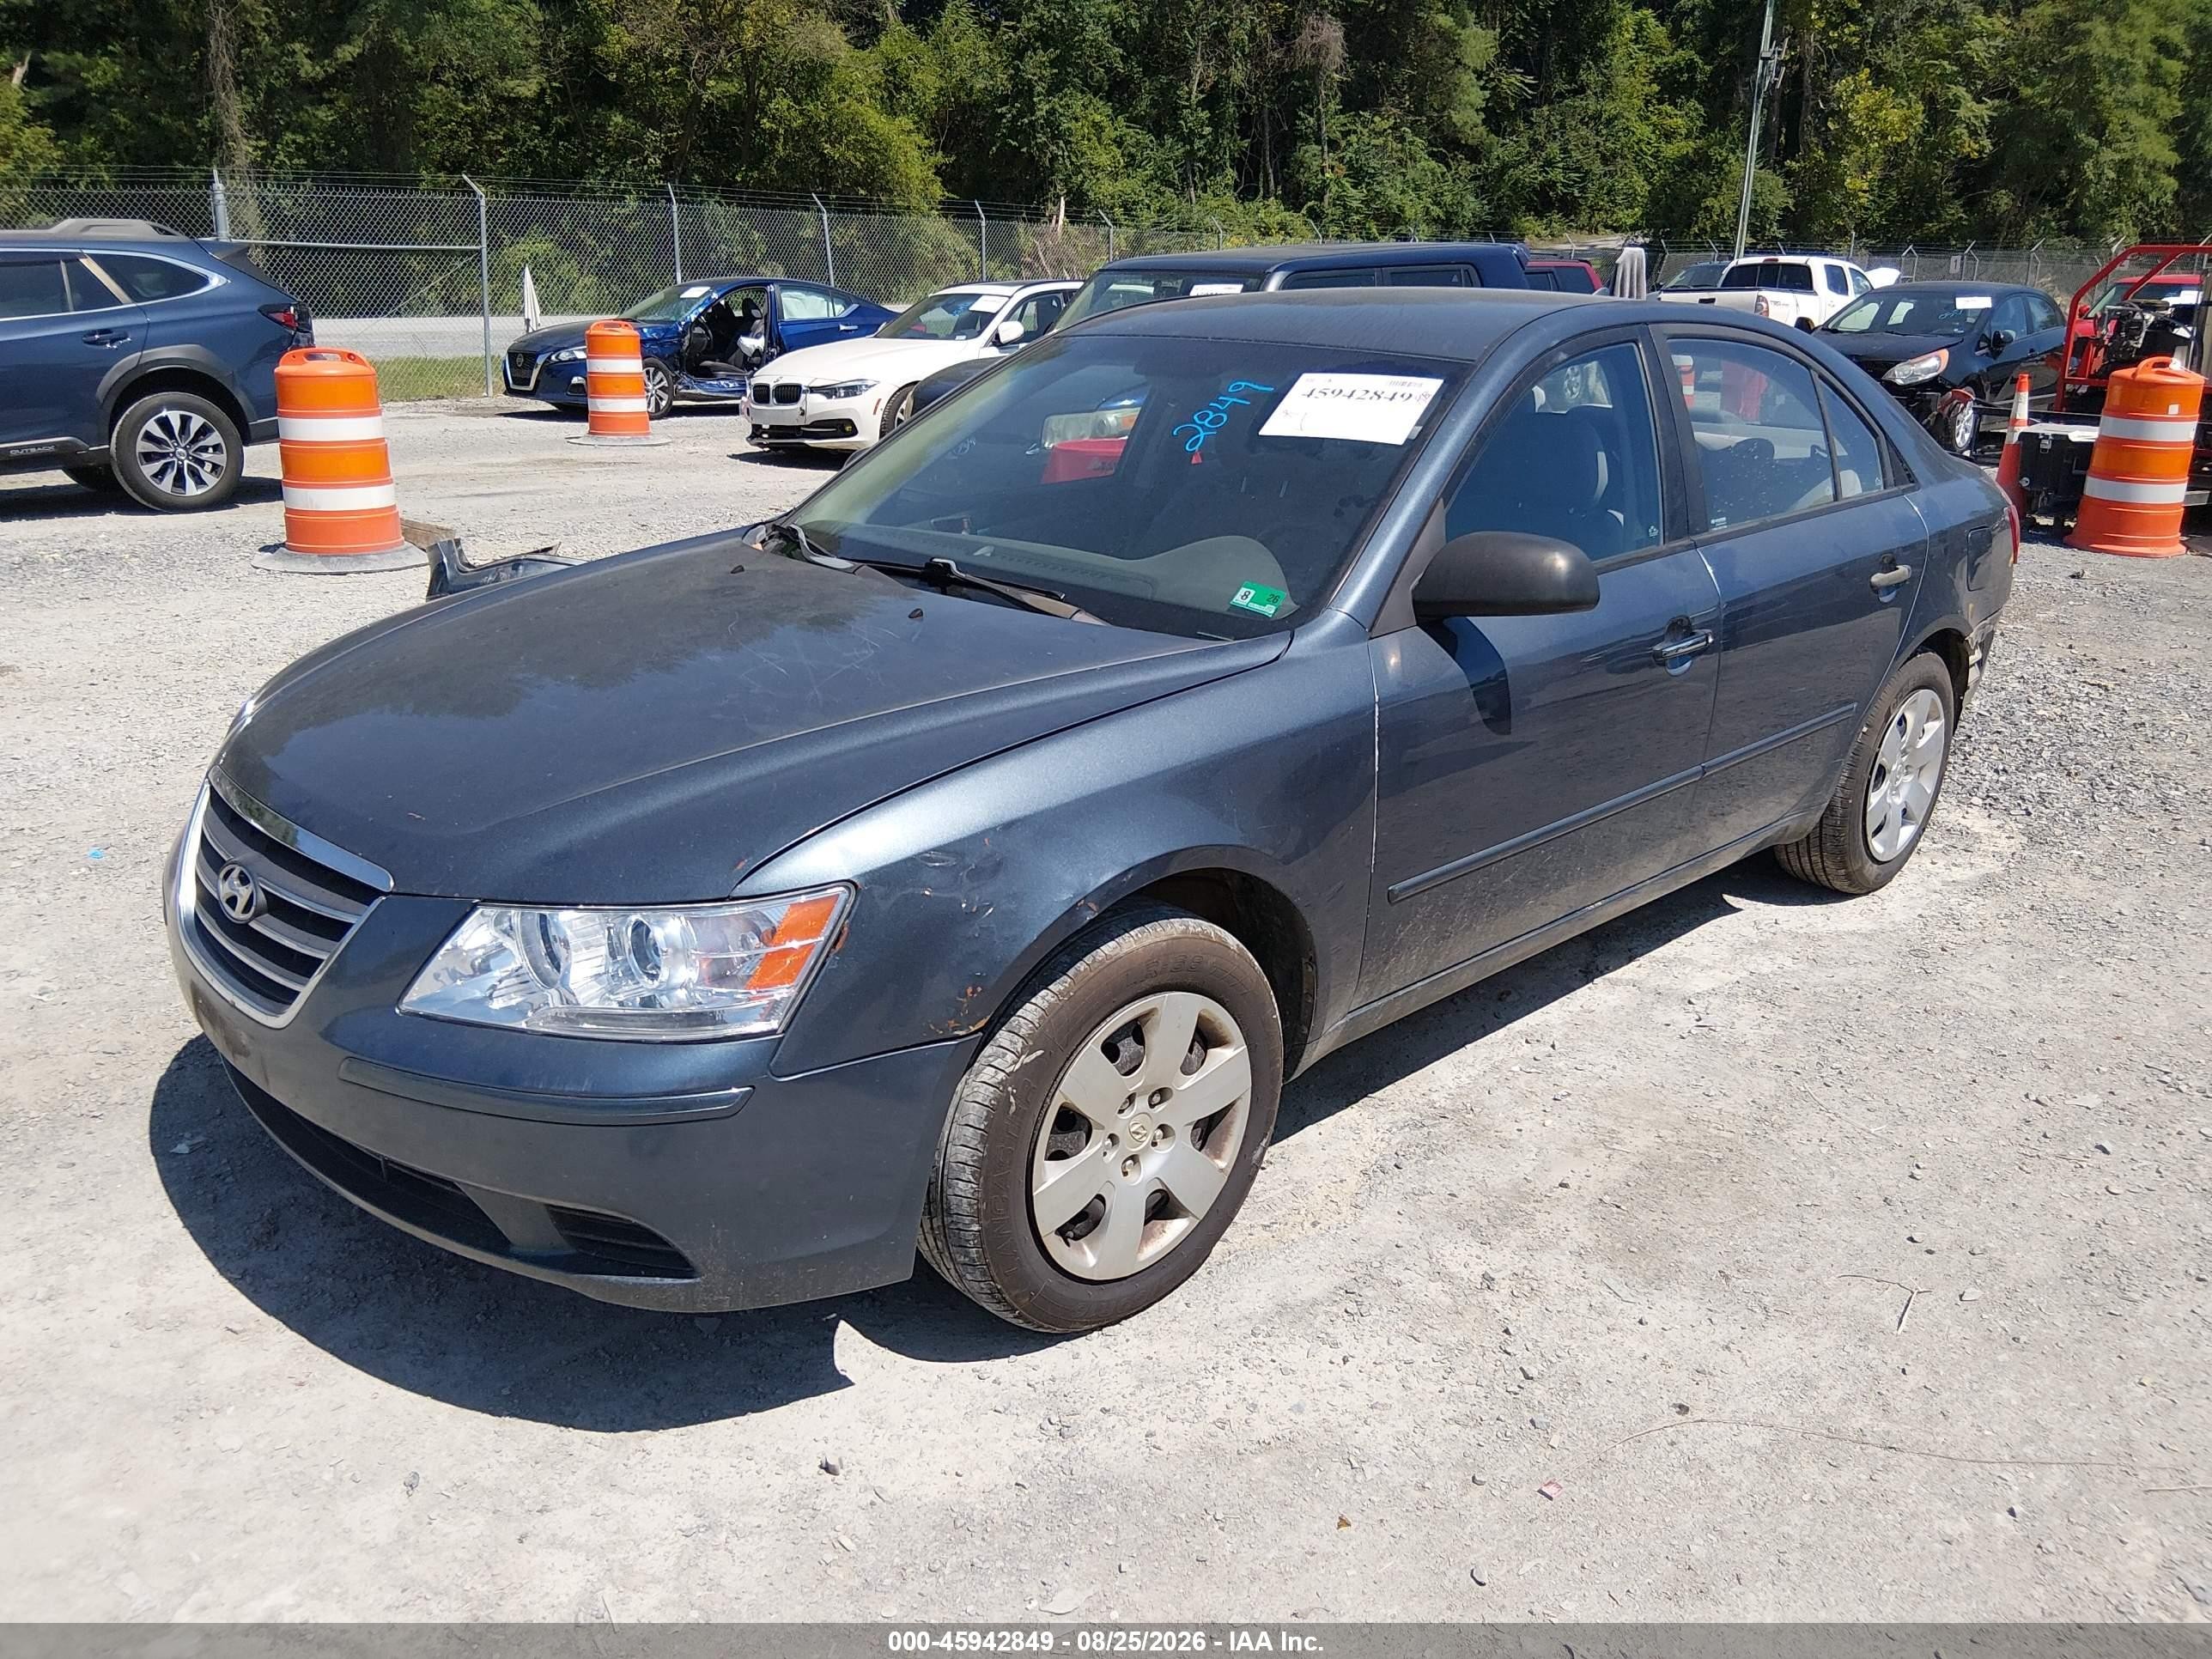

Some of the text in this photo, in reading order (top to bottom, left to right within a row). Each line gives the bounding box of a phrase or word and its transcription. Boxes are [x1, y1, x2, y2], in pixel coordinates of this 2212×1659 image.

[1301, 387, 1413, 403] 45942849
[1172, 380, 1274, 453] 2849
[9, 446, 55, 455] OUTBACK
[1241, 590, 1280, 604] 8 26
